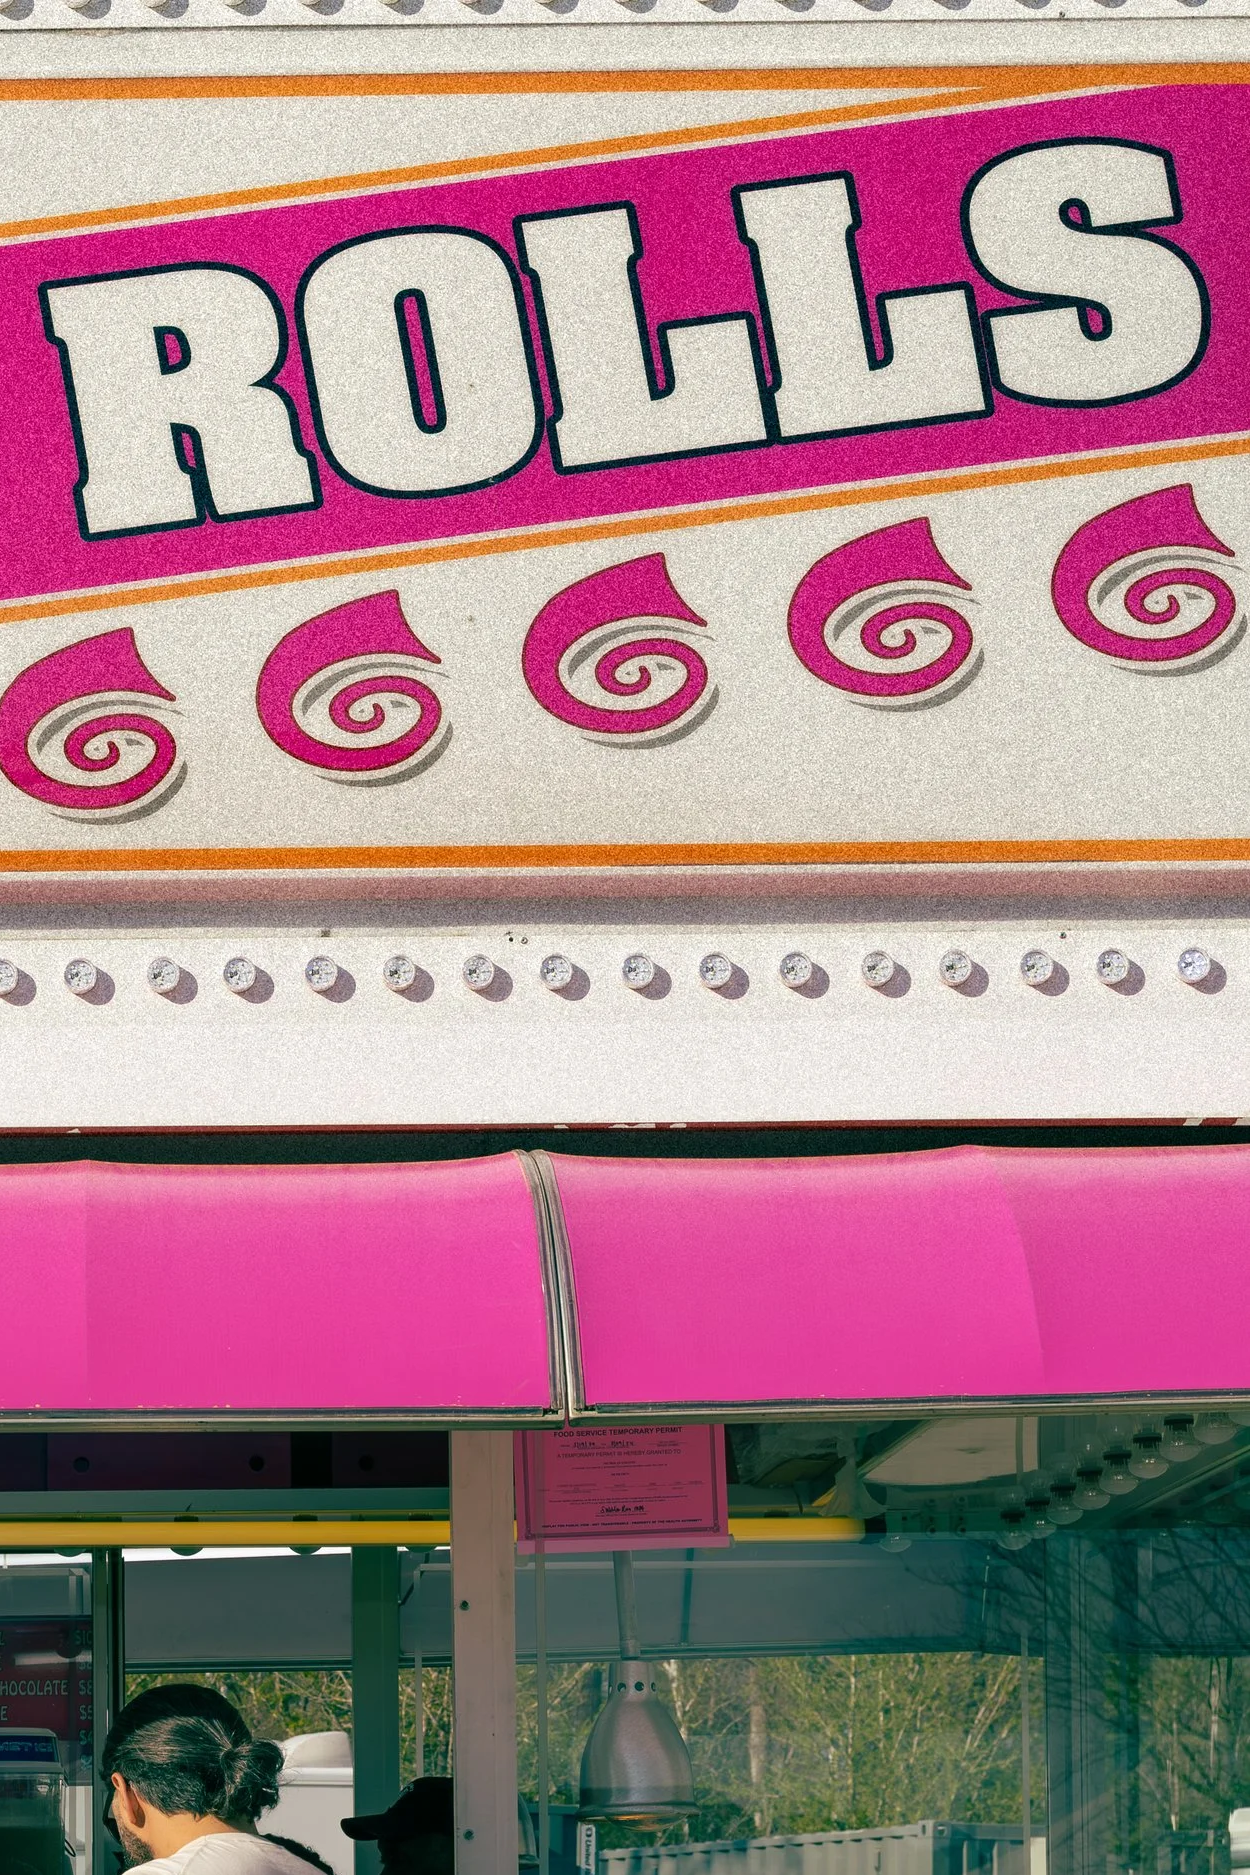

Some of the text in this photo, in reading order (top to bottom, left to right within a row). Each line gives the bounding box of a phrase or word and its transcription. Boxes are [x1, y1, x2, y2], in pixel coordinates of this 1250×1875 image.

[40, 137, 1212, 542] ROLLS
[609, 1428, 654, 1436] TEMPORARY
[656, 1427, 682, 1435] PERMIT
